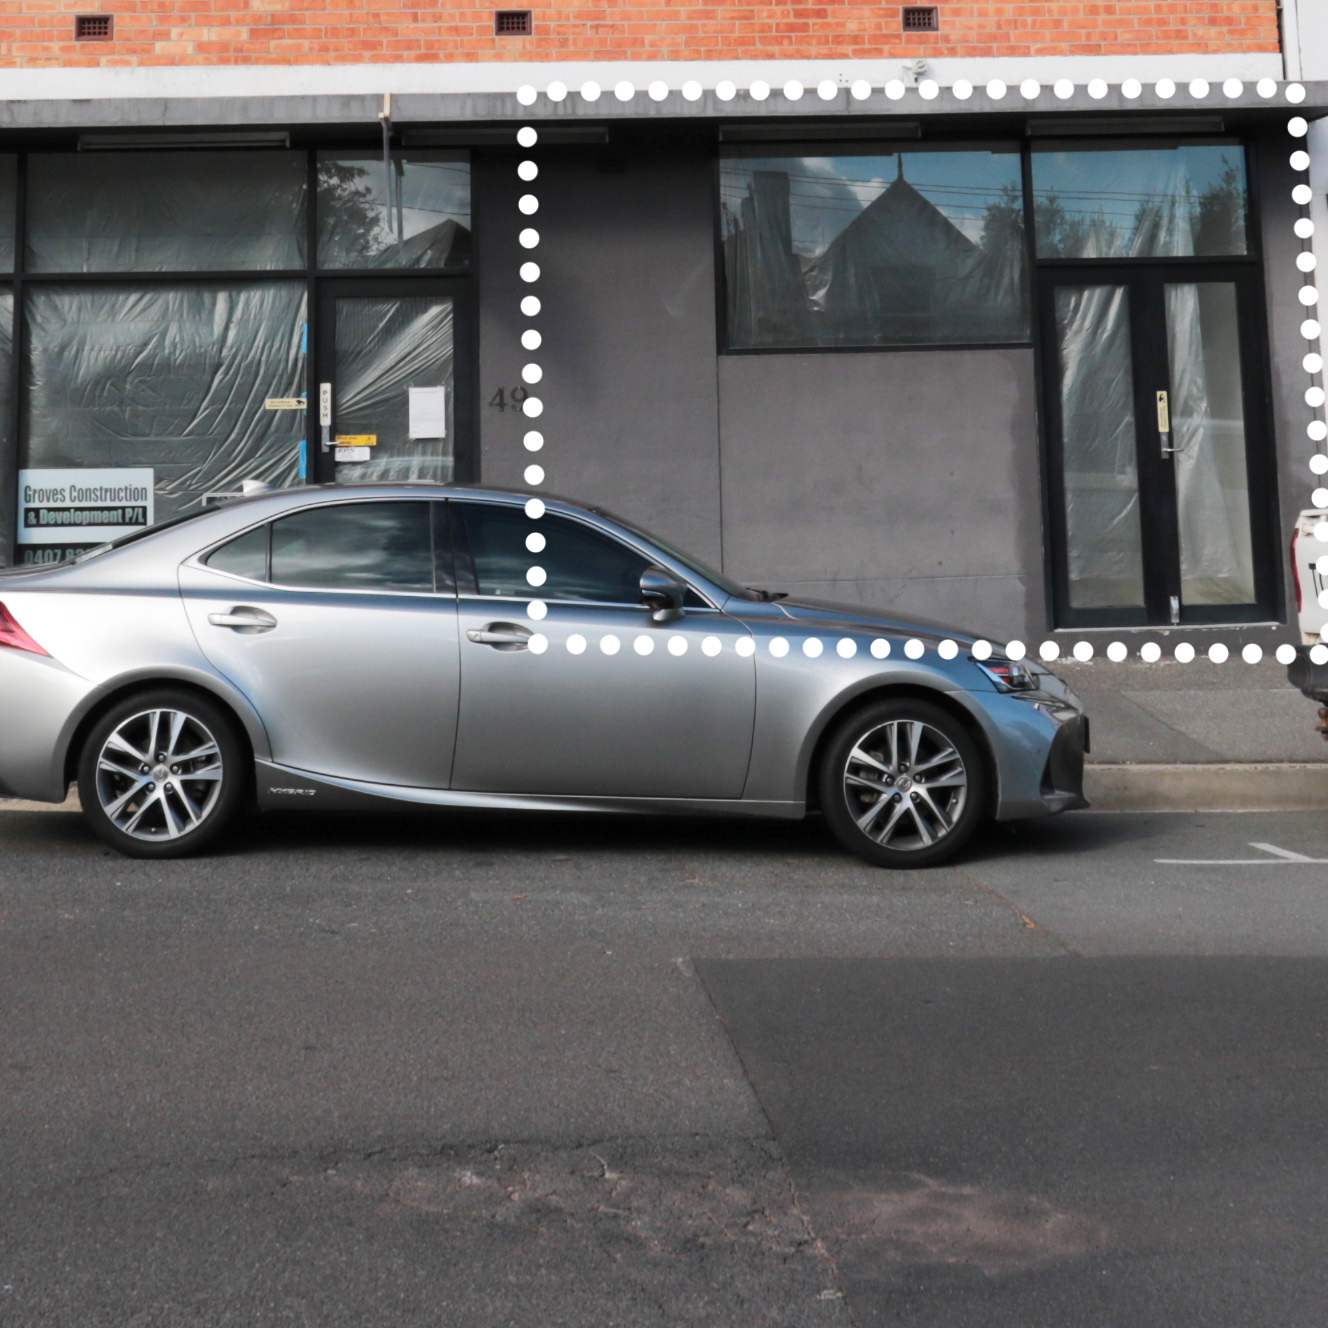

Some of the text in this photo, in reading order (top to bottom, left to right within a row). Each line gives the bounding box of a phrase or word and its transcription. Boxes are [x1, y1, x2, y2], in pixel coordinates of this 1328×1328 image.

[489, 386, 529, 413] 49
[24, 484, 147, 503] Groves Construction
[28, 508, 145, 526] & Development P/L
